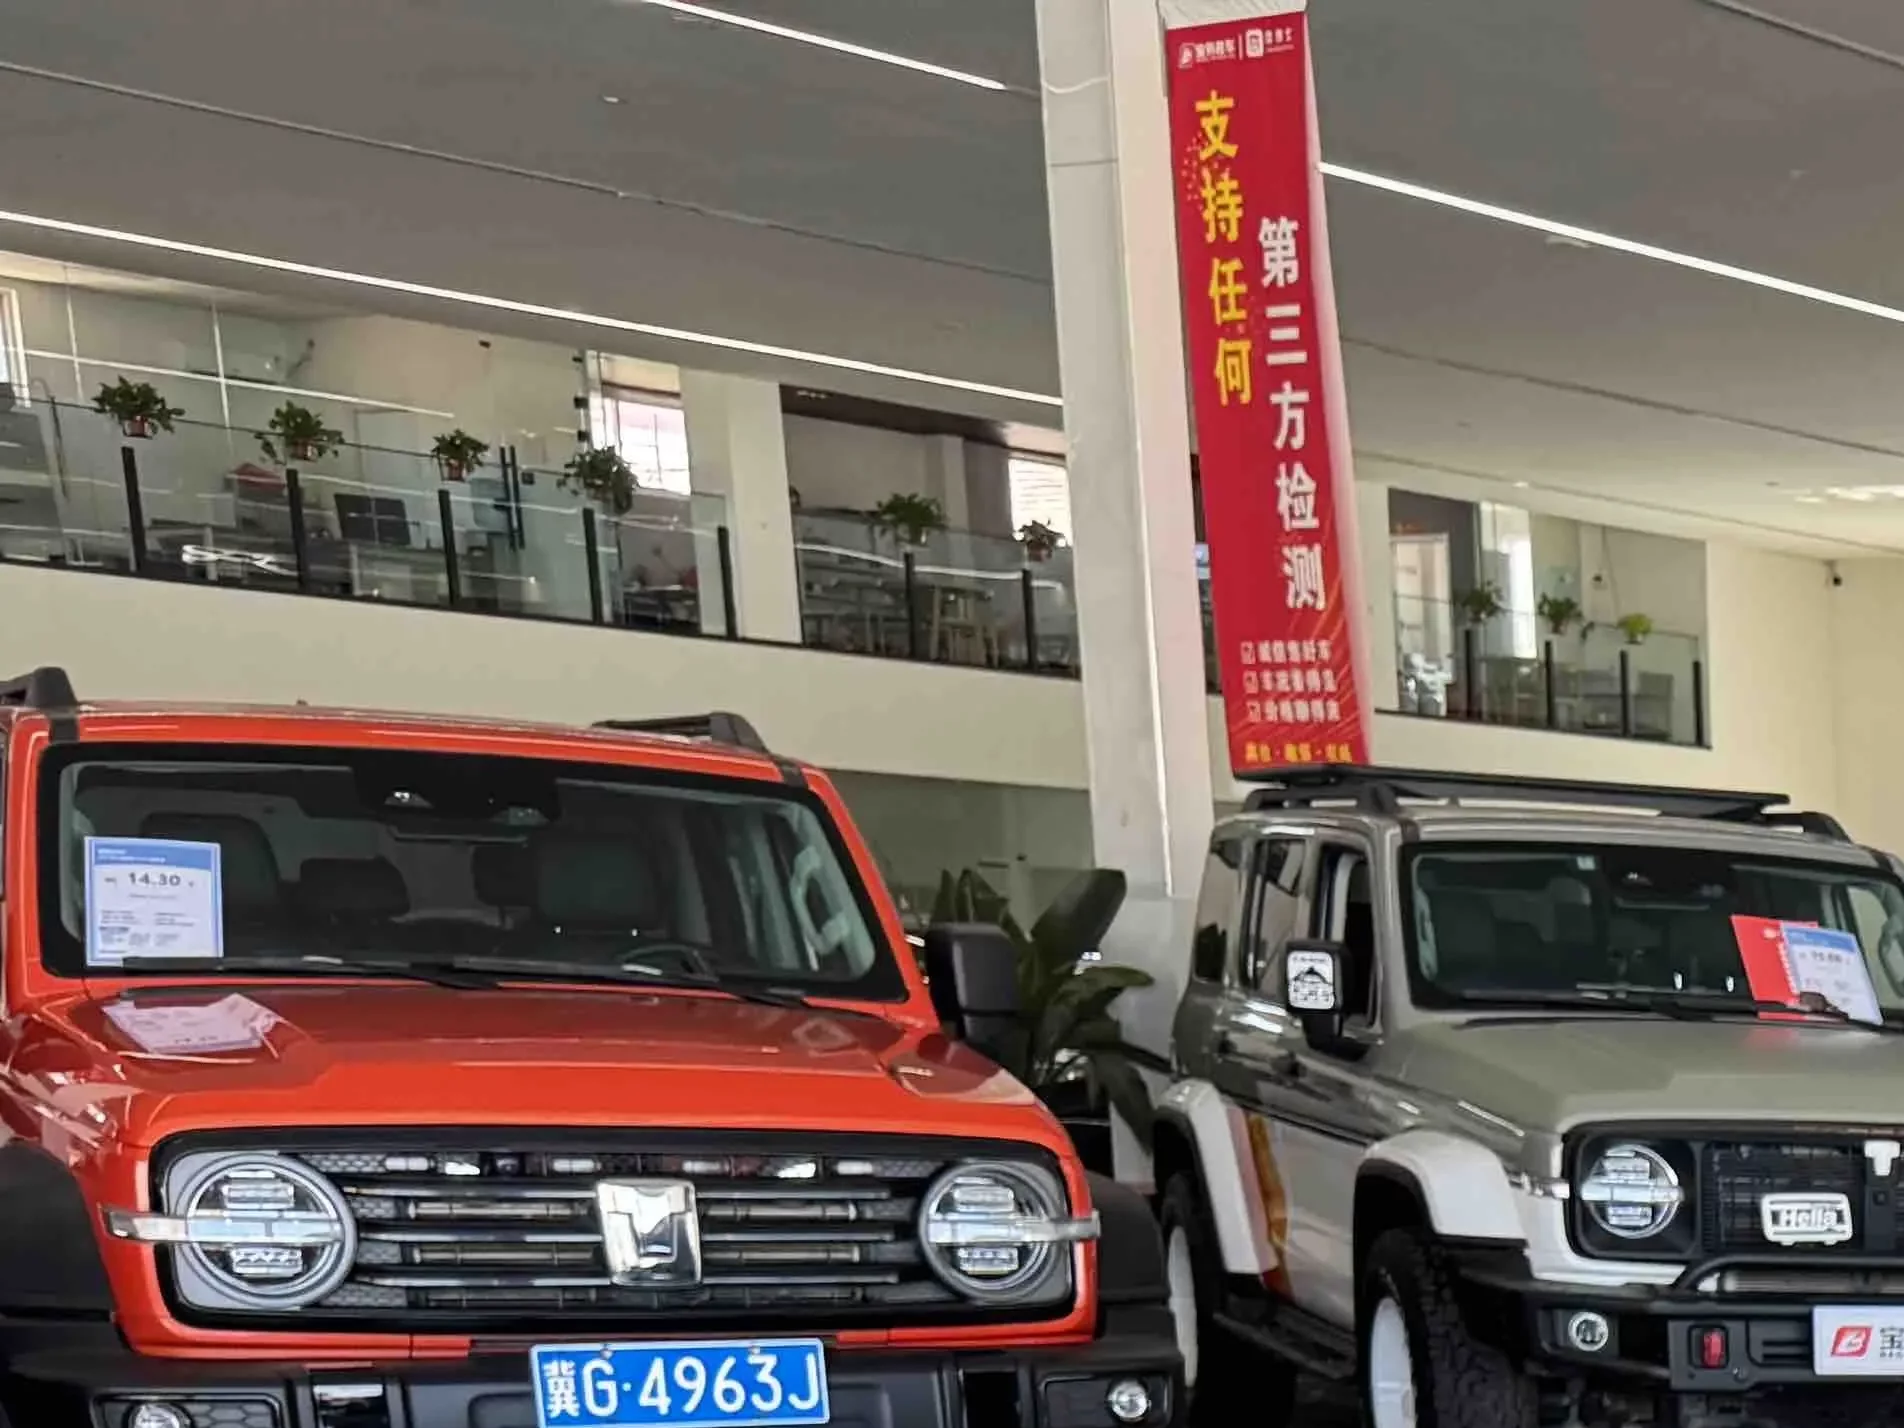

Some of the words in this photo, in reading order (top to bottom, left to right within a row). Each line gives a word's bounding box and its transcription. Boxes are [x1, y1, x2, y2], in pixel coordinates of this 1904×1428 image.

[1195, 90, 1252, 406] 支持任何
[1258, 216, 1326, 610] 第三方检测
